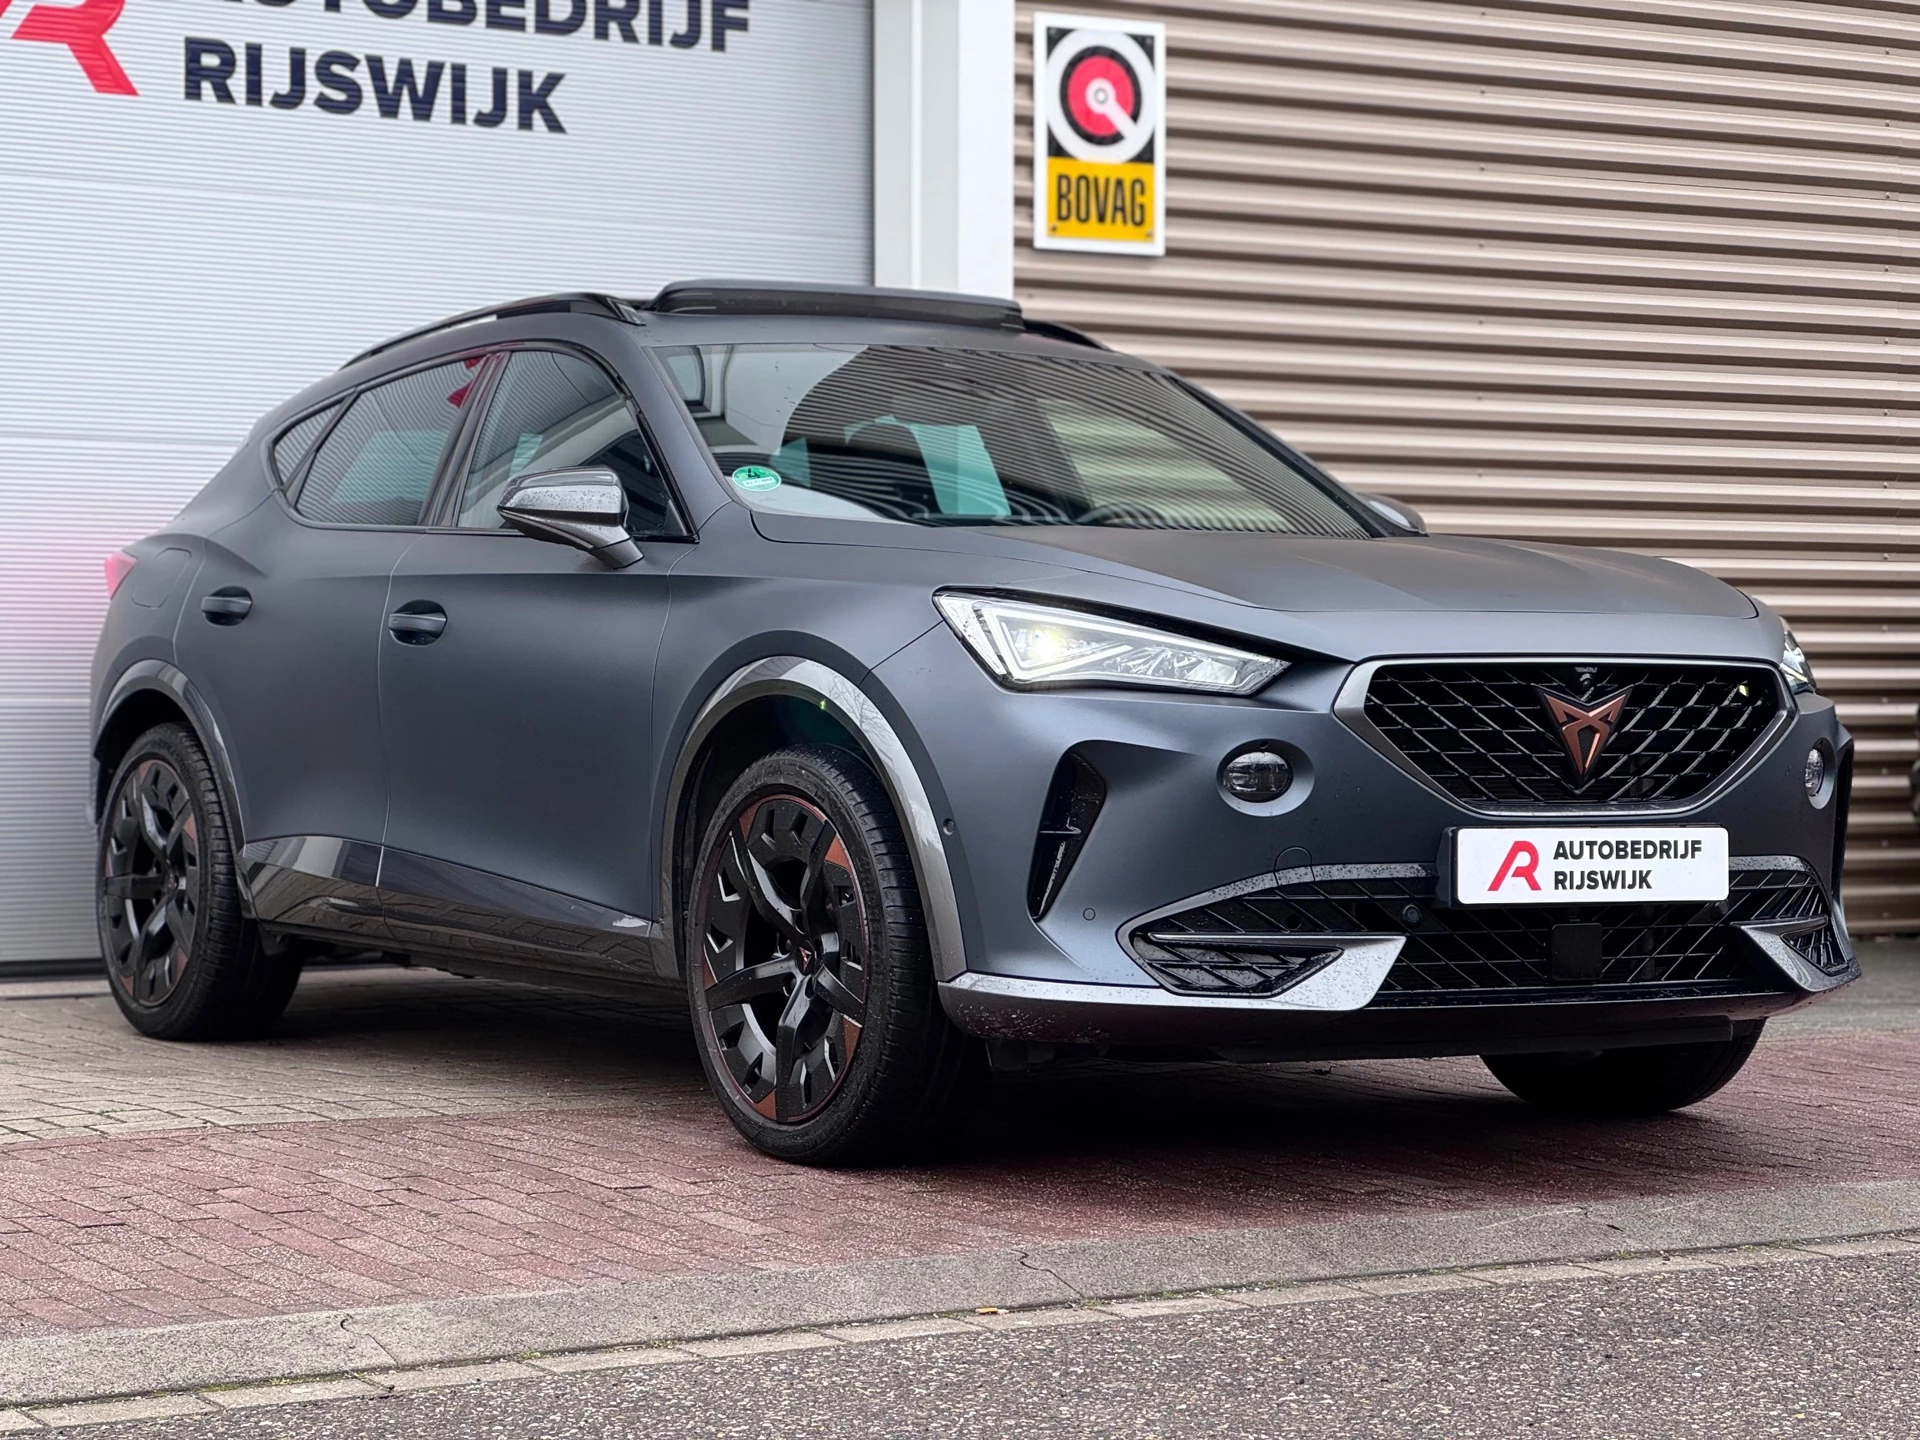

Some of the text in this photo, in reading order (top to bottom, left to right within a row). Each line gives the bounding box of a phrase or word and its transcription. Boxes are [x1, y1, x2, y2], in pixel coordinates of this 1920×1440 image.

[216, 0, 749, 52] EDRIJF
[184, 36, 567, 134] RIJSWIJK
[1056, 174, 1146, 227] BOVAG
[1553, 839, 1702, 860] AUTOBEDRIJF
[1554, 869, 1653, 890] RIJSWIJK
